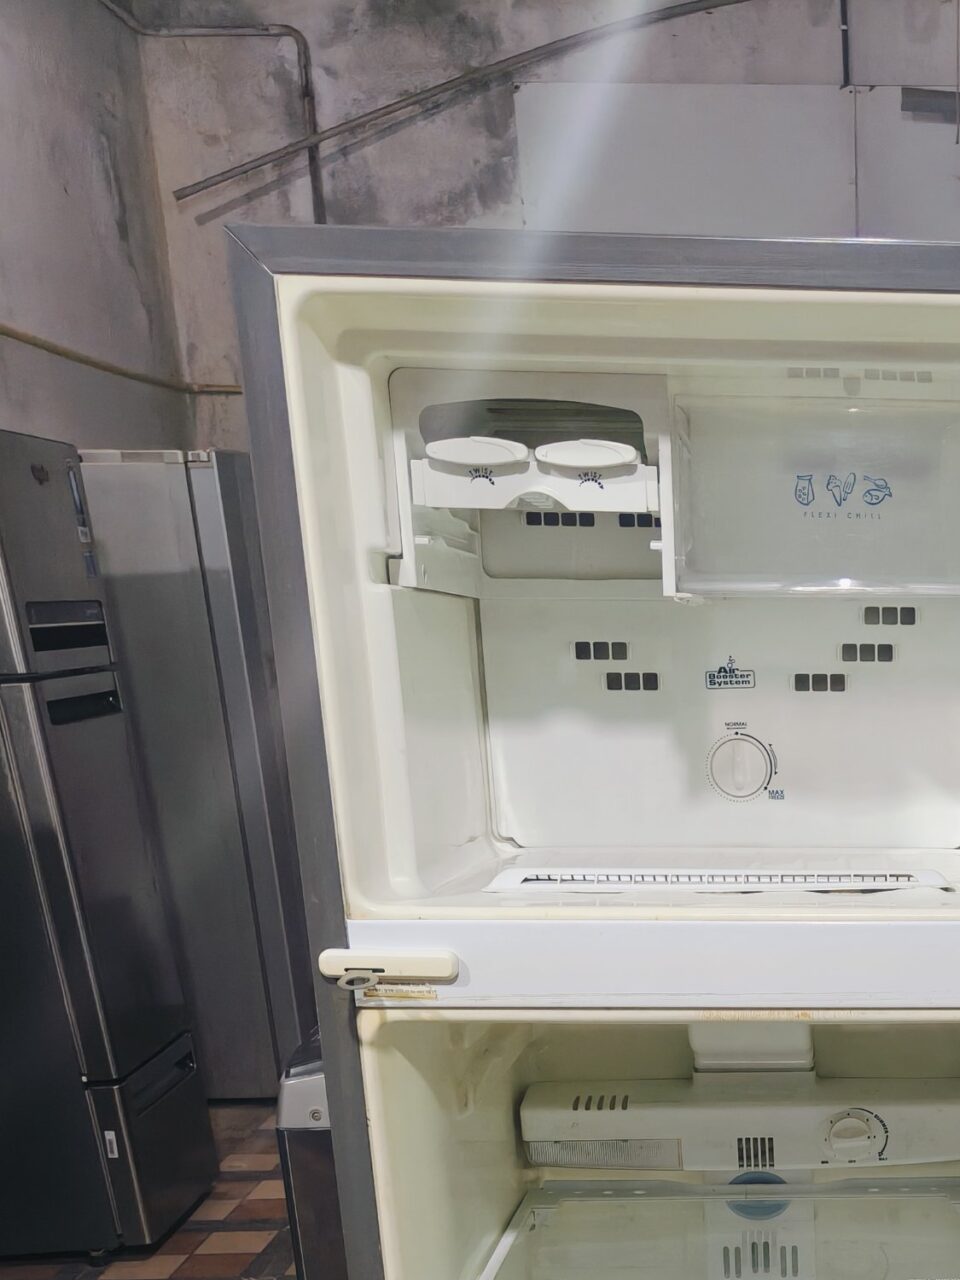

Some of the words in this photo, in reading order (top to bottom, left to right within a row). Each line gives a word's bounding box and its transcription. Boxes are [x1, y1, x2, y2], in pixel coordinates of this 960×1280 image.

[468, 467, 494, 477] TWIST
[577, 471, 603, 480] TWIST
[803, 511, 838, 519] FLEXI
[717, 666, 740, 675] Air
[708, 679, 752, 687] System
[768, 789, 785, 797] MAX
